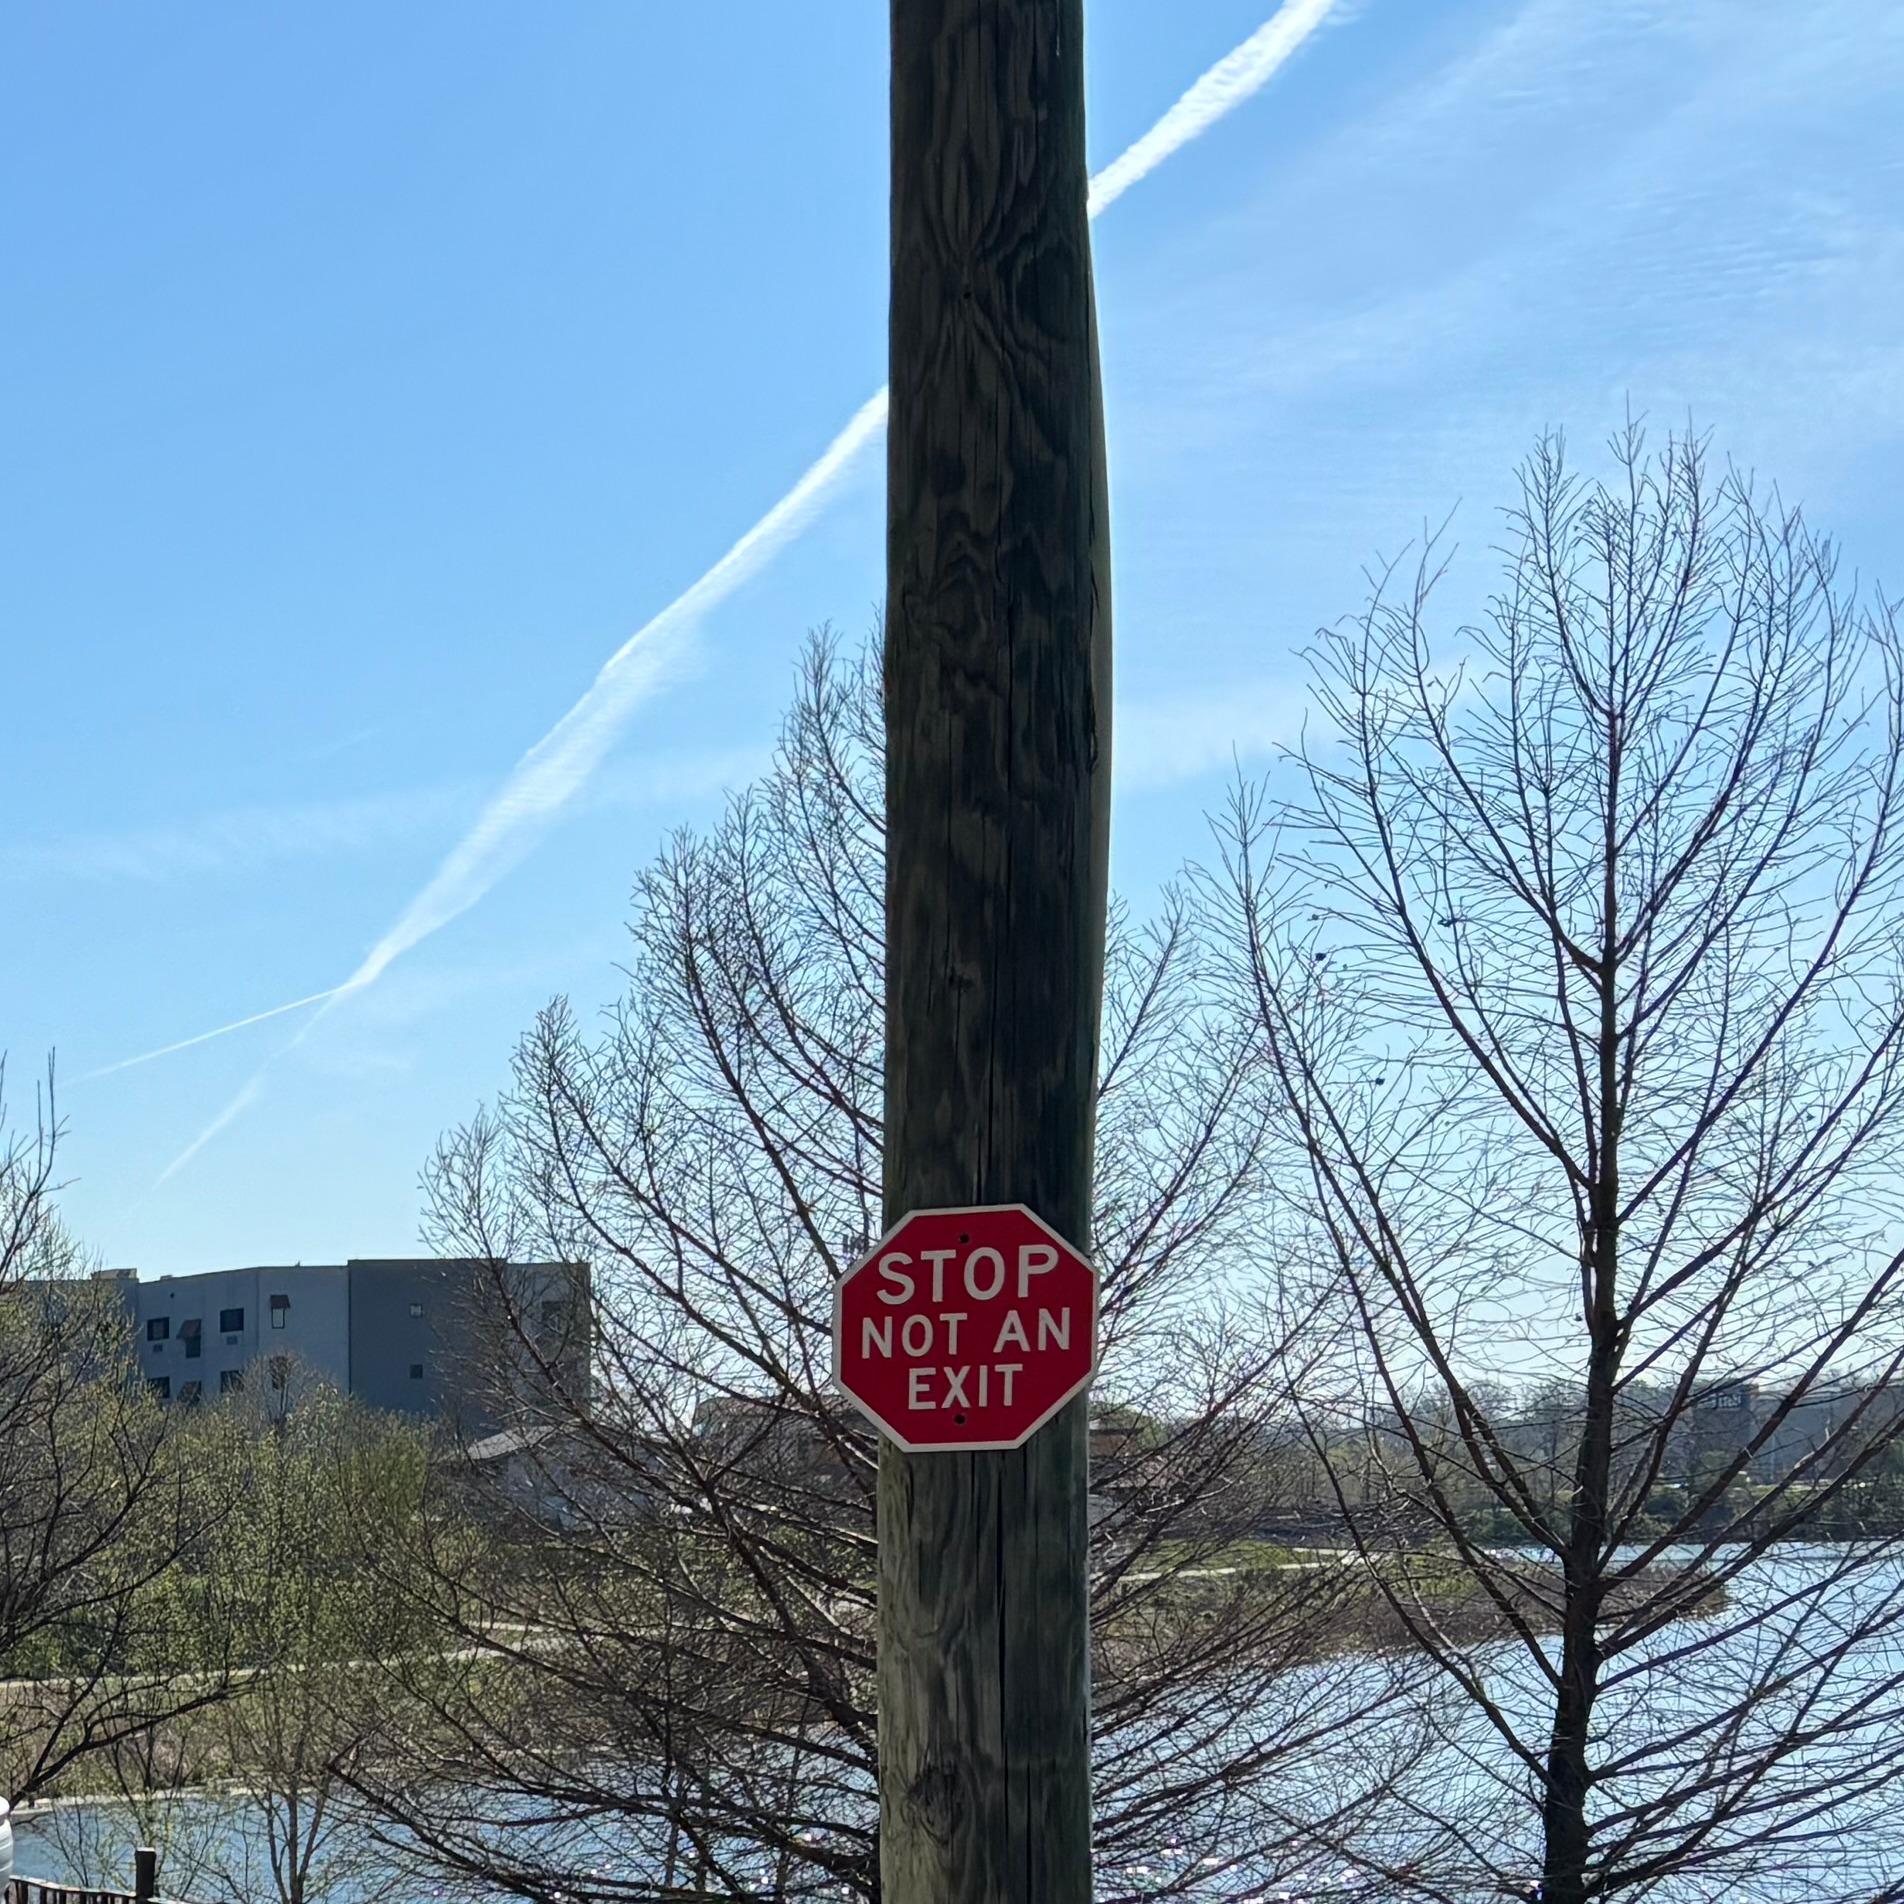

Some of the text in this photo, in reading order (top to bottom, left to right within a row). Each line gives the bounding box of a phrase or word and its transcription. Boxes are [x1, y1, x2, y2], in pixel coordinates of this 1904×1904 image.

[877, 1245, 1059, 1305] STOP
[862, 1308, 1071, 1359] NOT AN
[909, 1364, 1023, 1410] EXIT
